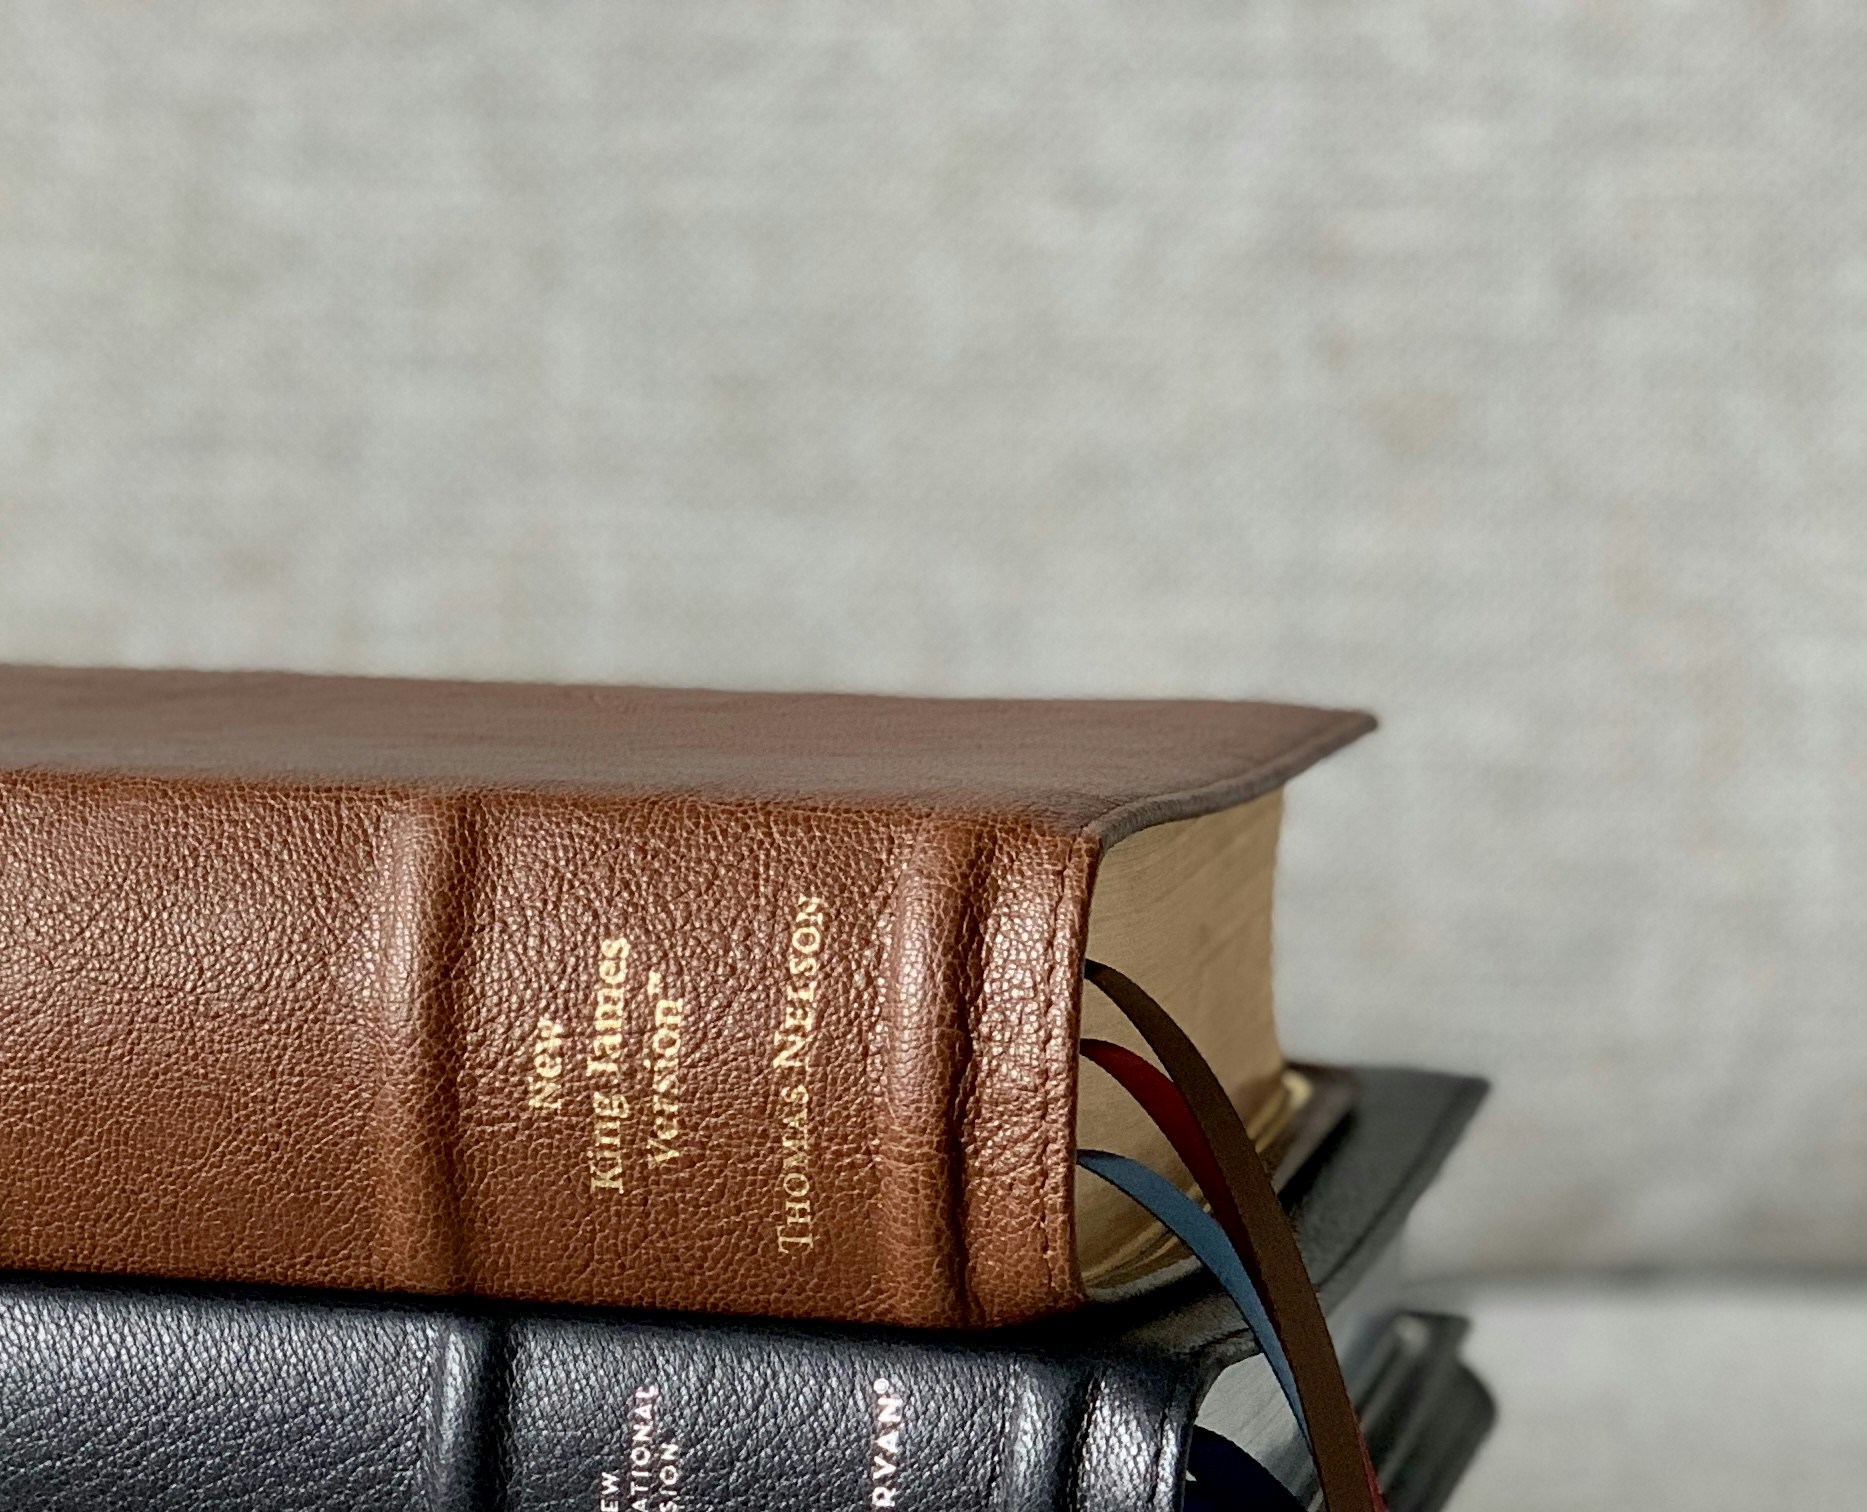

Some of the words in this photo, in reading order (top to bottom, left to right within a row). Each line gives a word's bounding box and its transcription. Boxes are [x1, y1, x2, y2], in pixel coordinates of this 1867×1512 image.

[586, 937, 631, 1076] James
[527, 1014, 564, 1112] New
[589, 1089, 630, 1195] King
